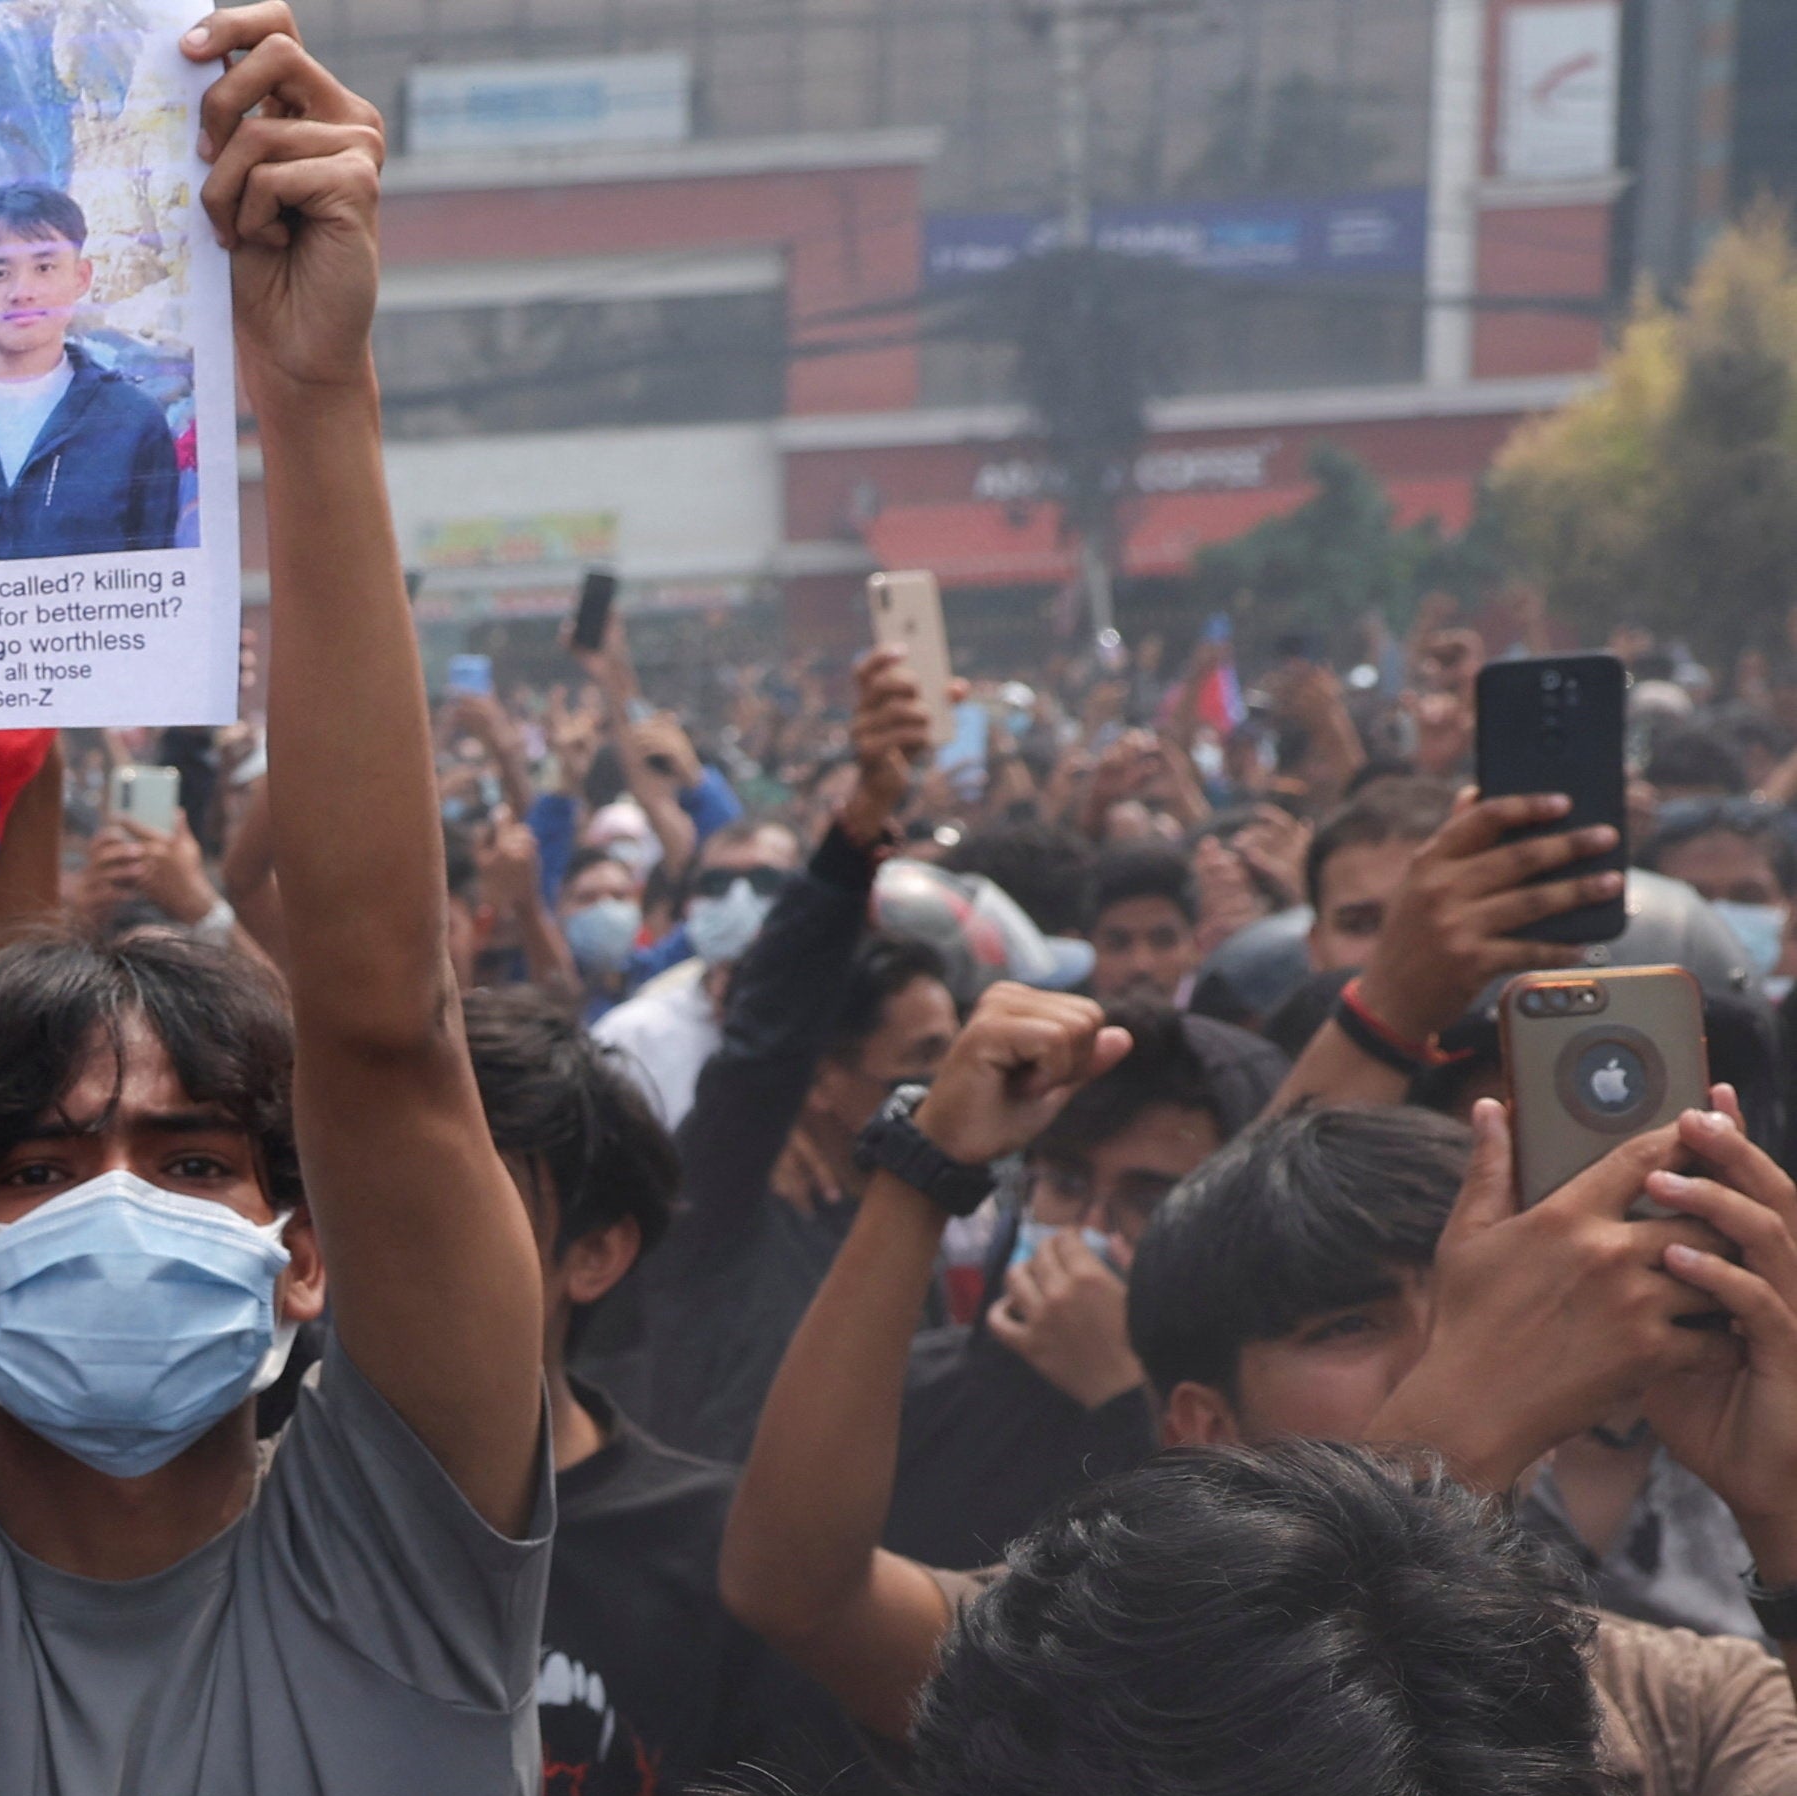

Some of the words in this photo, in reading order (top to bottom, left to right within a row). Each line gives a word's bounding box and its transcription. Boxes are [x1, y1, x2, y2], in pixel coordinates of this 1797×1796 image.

[94, 568, 163, 593] killing
[171, 570, 186, 587] a
[36, 596, 183, 624] betterment?
[30, 630, 146, 653] worthless
[5, 662, 28, 682] all
[34, 662, 93, 681] those
